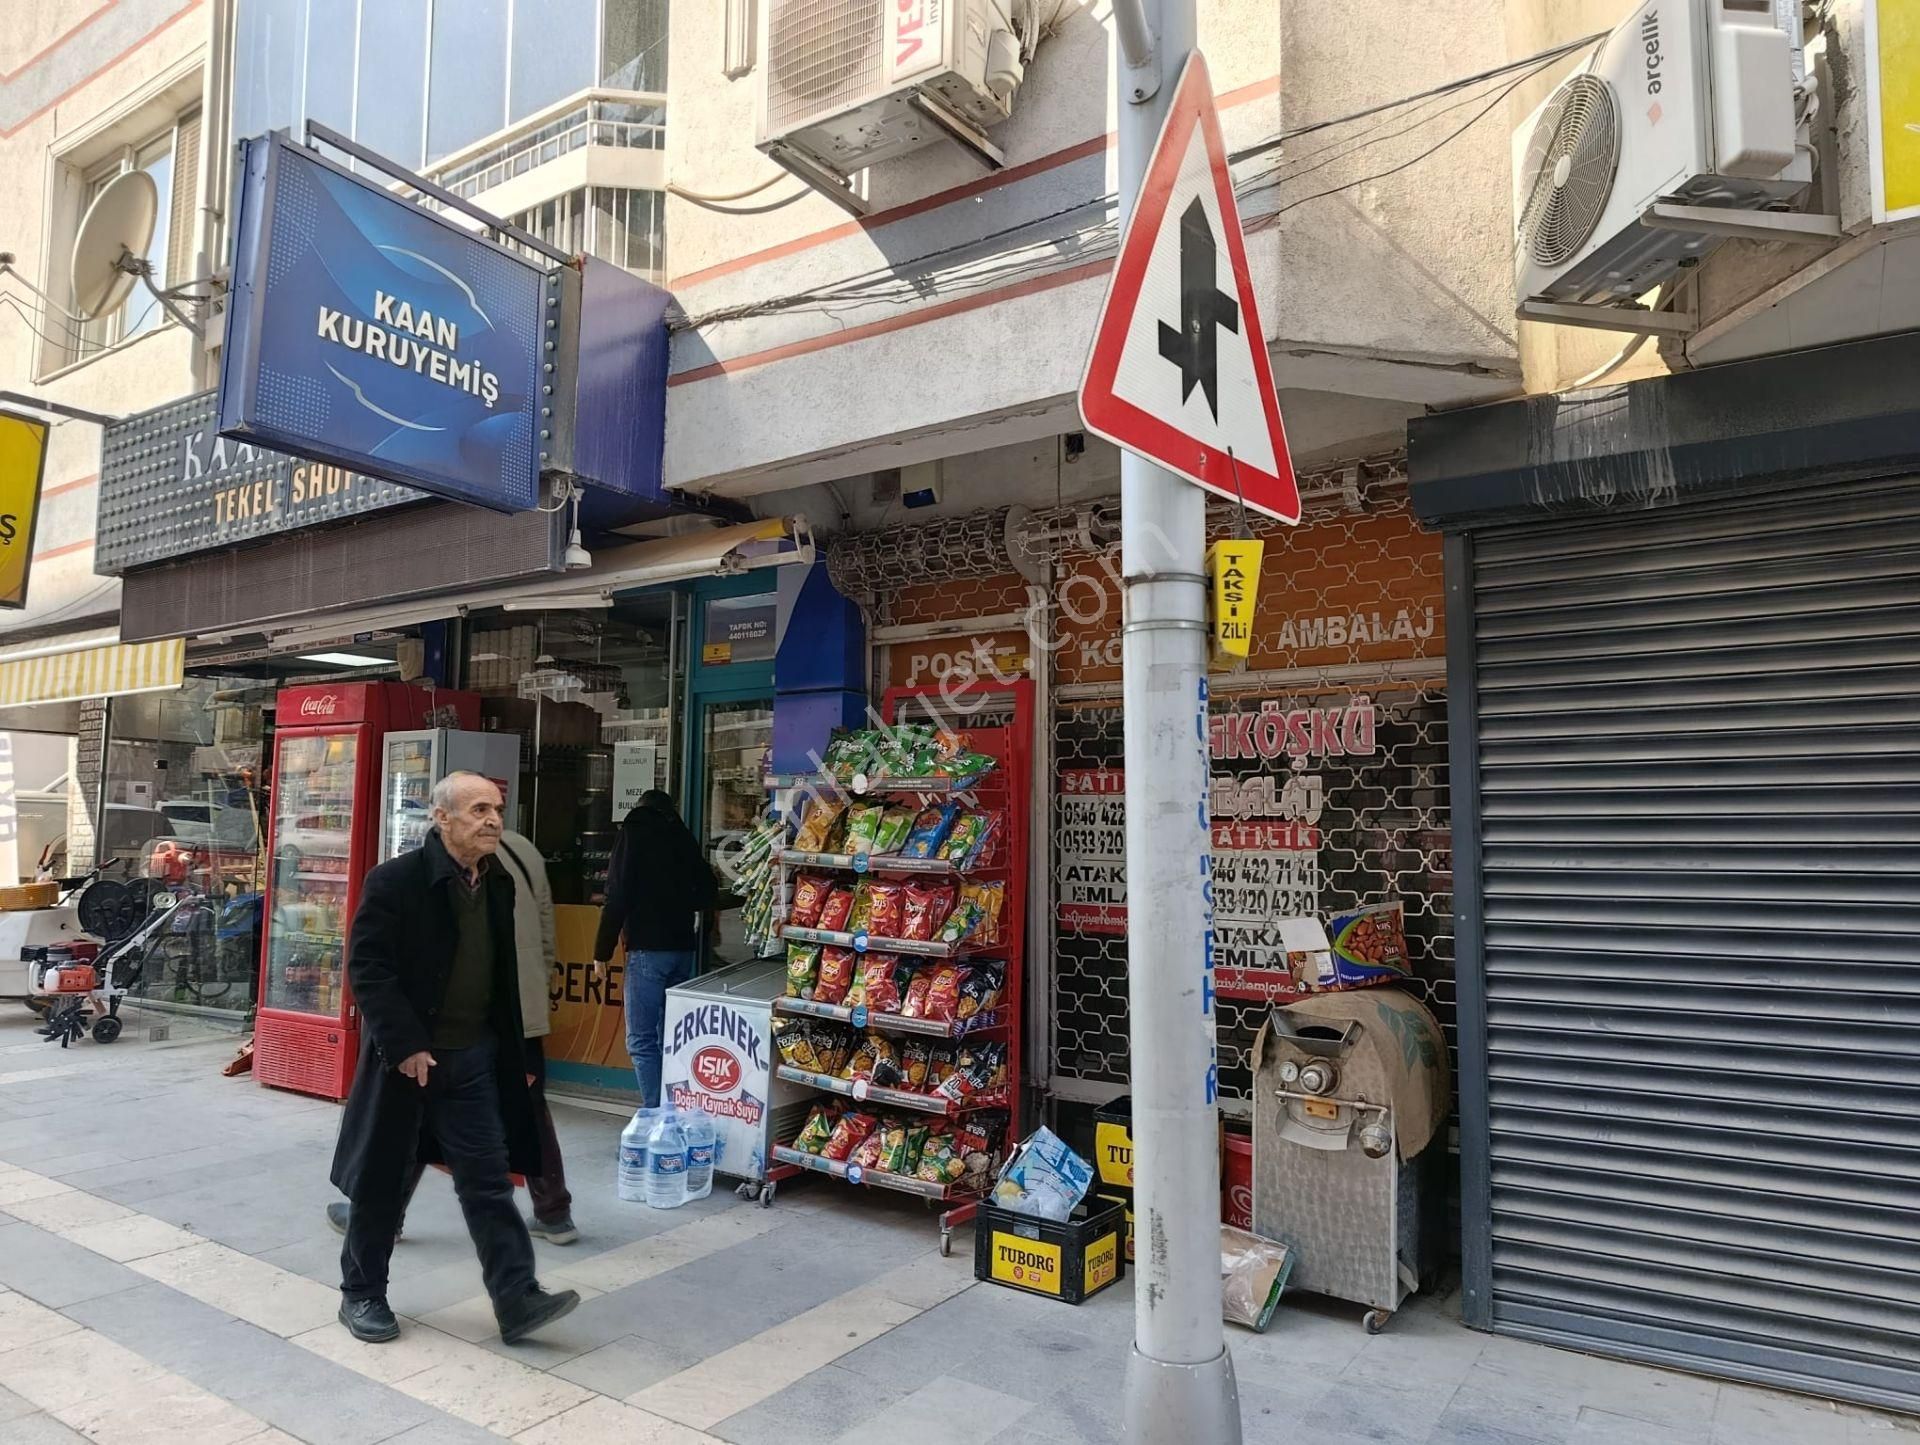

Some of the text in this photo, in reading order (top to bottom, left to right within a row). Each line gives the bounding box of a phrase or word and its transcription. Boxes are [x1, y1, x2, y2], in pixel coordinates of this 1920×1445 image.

[1641, 9, 1663, 97] arçelik
[374, 290, 457, 350] KAAN
[318, 306, 499, 408] KURUYEMİŞ
[215, 480, 274, 526] TEKEL
[1222, 555, 1245, 616] TAKSİ
[1277, 607, 1435, 650] AMBALAJ
[626, 788, 643, 796] MEZE
[1065, 772, 1119, 791] SATI
[1217, 825, 1313, 847] ATILIK
[1213, 949, 1286, 970] EMLA
[548, 961, 624, 1012] ÇERE
[698, 1055, 735, 1078] IŞIK
[675, 1088, 760, 1124] Doğal Kaynak Suyu
[1229, 1213, 1253, 1227] ALG
[998, 1245, 1115, 1273] TUBORG TUBORG
